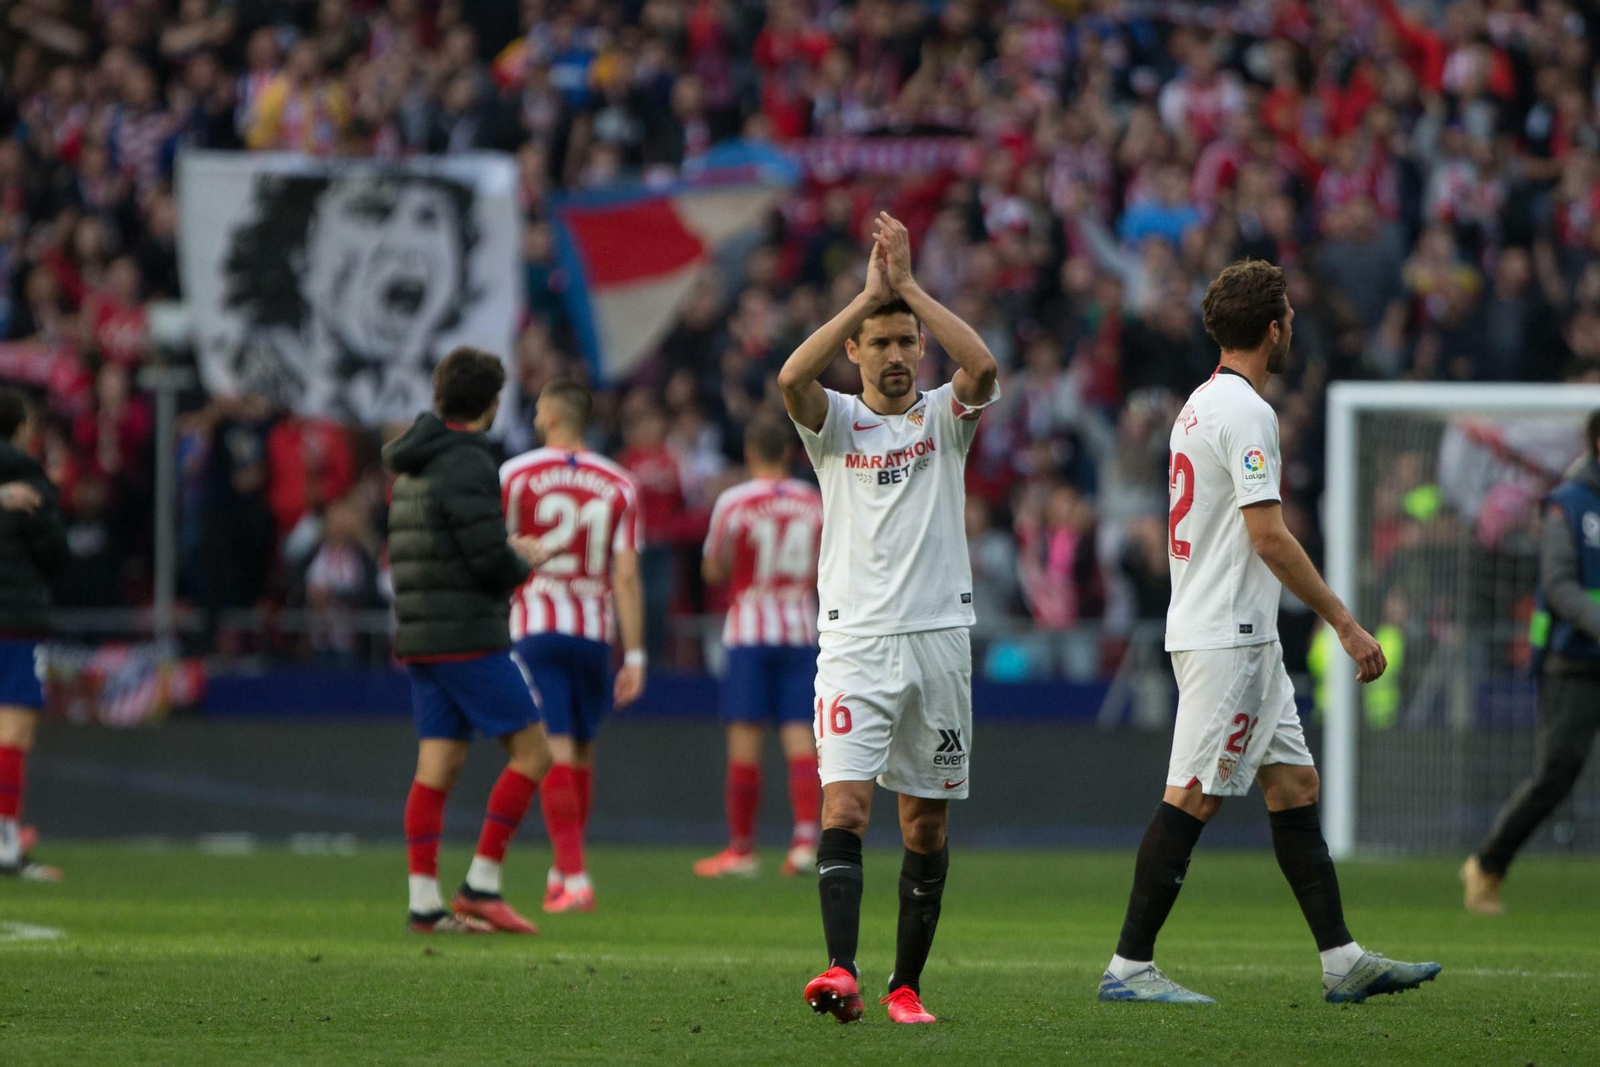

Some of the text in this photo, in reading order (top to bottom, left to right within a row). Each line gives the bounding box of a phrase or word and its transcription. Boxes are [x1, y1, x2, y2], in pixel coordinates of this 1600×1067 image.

[845, 437, 935, 469] MARATHON
[877, 464, 910, 485] BET
[1245, 472, 1266, 480] LaLiga
[1169, 449, 1195, 561] 2
[533, 492, 612, 575] 21
[747, 518, 812, 579] 14
[816, 693, 853, 739] 16
